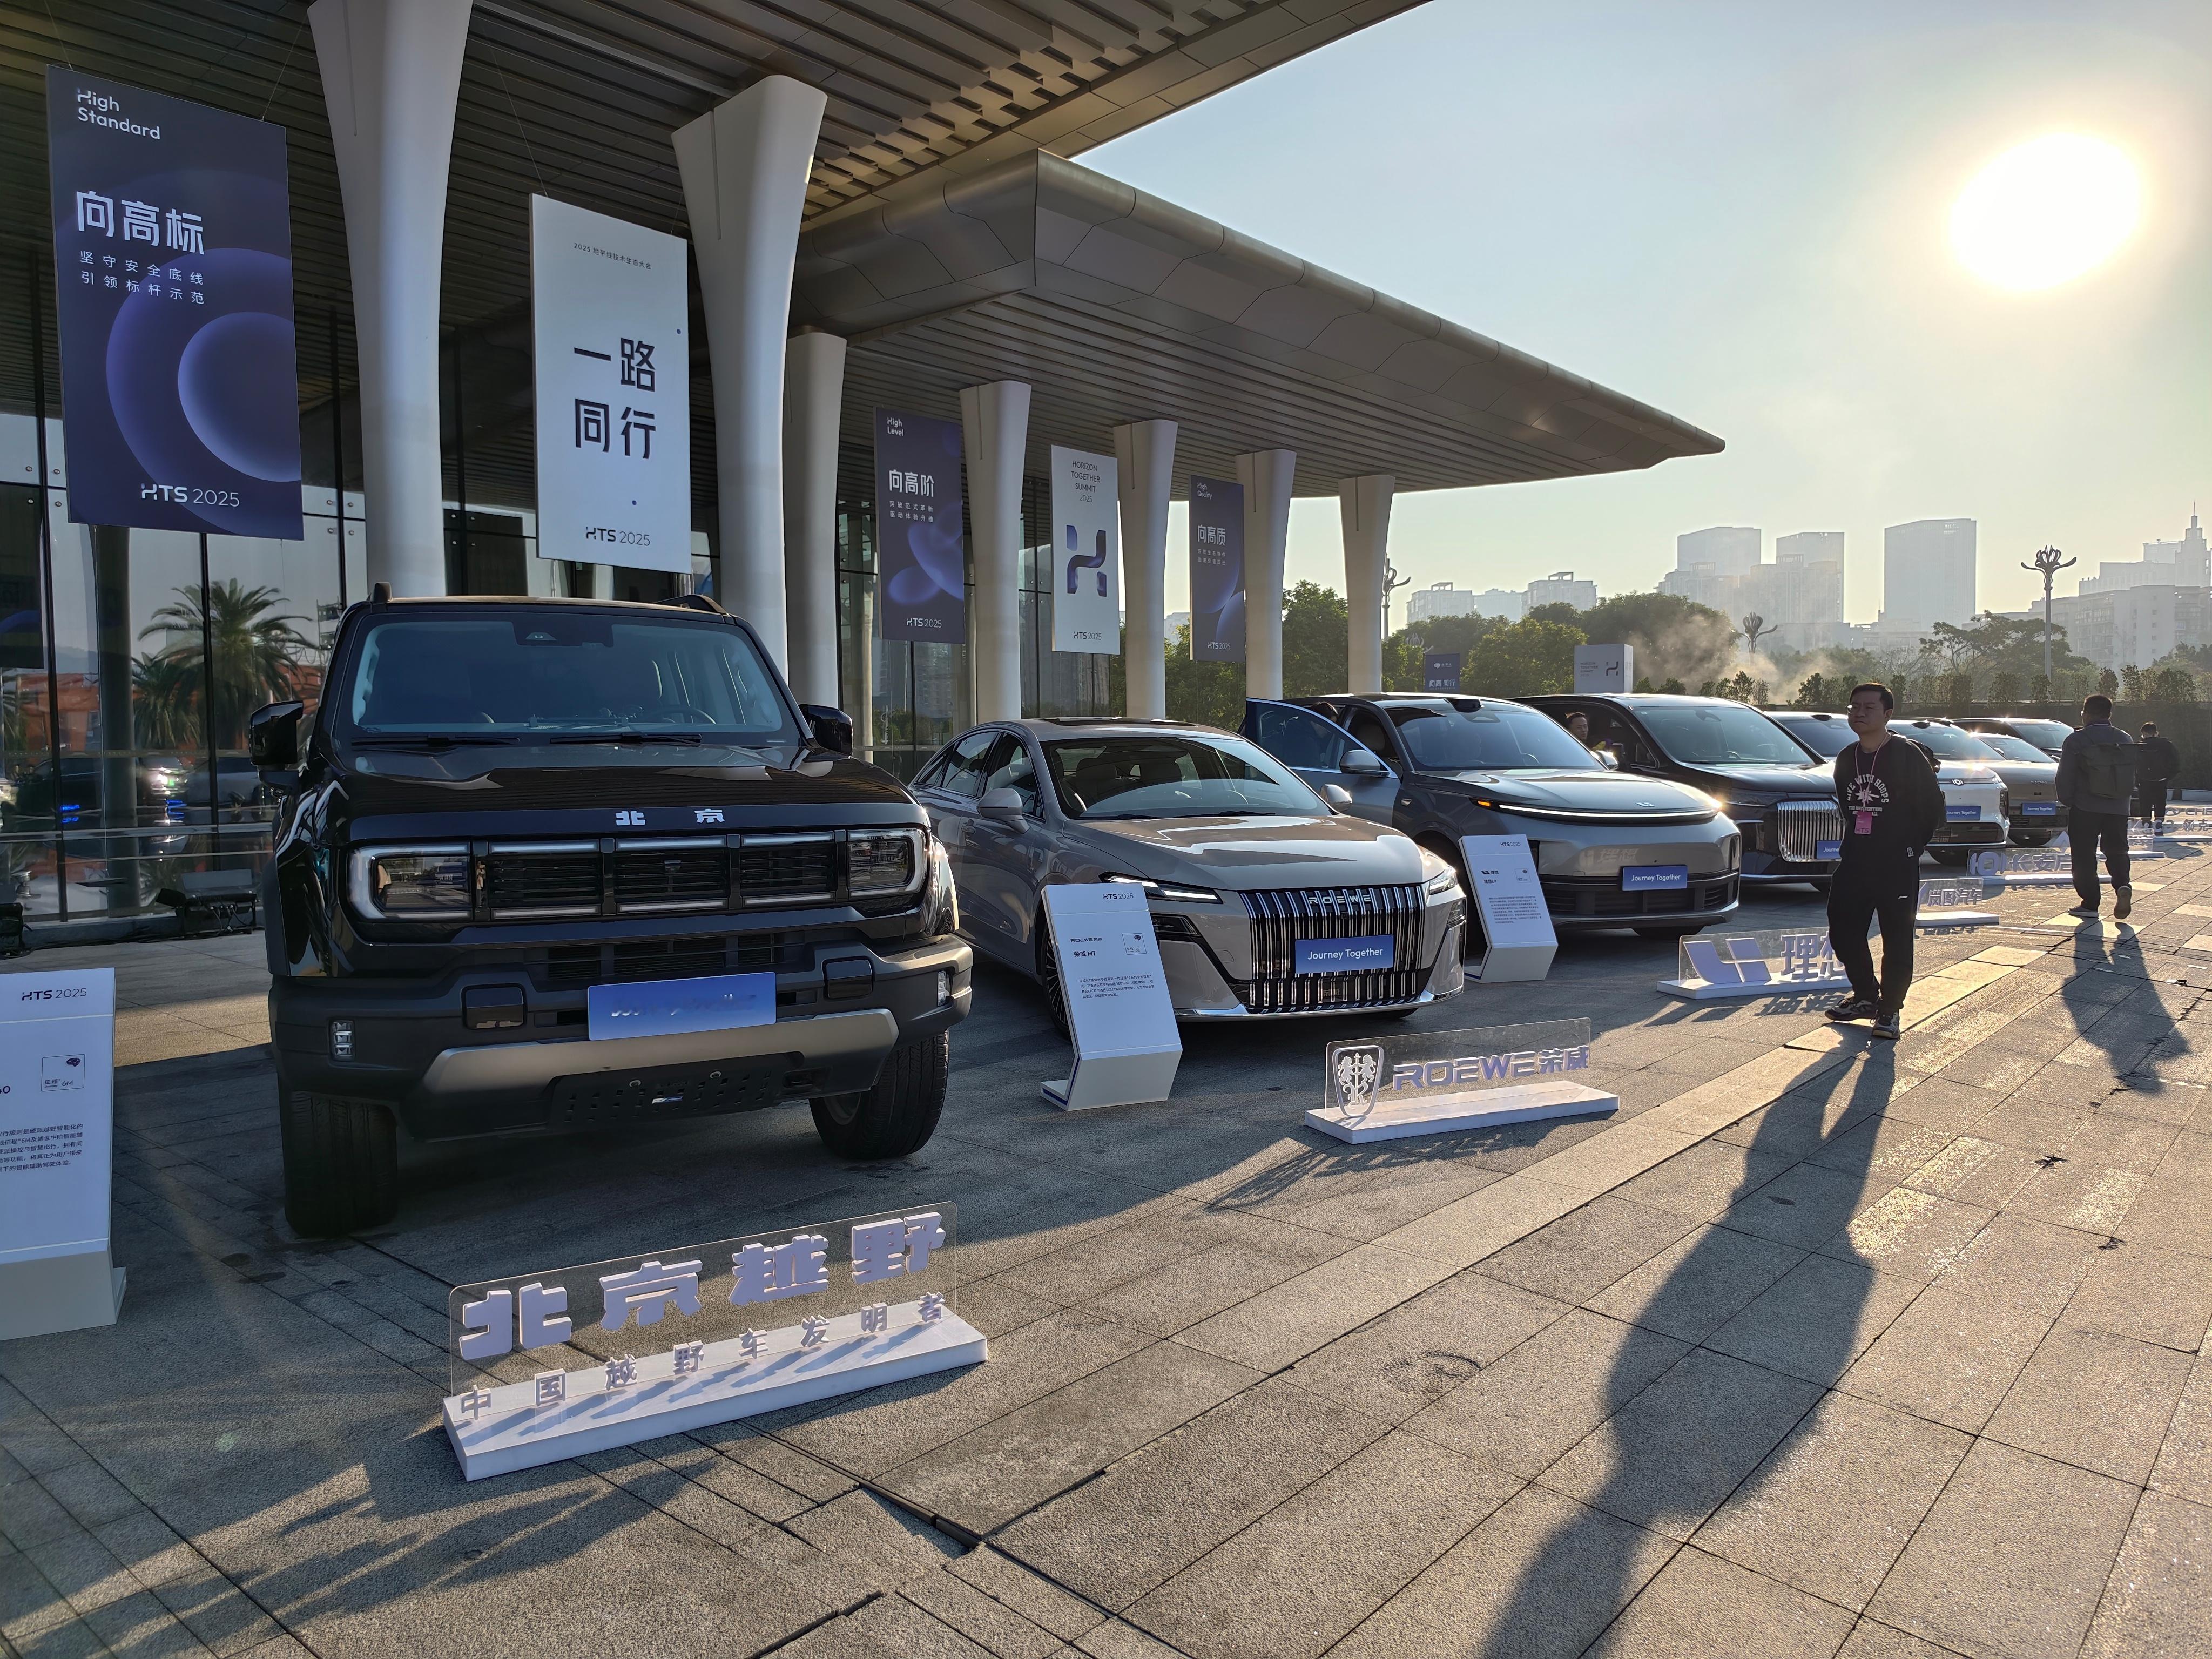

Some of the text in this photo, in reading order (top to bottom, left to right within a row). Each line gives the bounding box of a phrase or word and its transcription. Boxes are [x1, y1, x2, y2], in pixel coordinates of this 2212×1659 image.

[78, 88, 119, 112] High
[78, 108, 160, 139] Standard
[77, 191, 205, 254] 向高标
[574, 243, 590, 252] 2025
[80, 251, 203, 285] 坚守安全底线
[81, 271, 204, 305] 引领标杆示范
[574, 337, 656, 392] 一路
[575, 399, 656, 459] 同行
[887, 416, 902, 428] High
[887, 427, 904, 436] Level
[1072, 460, 1097, 471] HORIZON
[889, 469, 934, 497] 向高阶
[1071, 471, 1101, 483] TOGETHER
[141, 483, 240, 507] HTS 2025
[1075, 483, 1097, 493] SUMMIT
[1197, 490, 1212, 500] Quality
[1080, 494, 1092, 503] 2025
[586, 527, 650, 546] HTS 2025
[1197, 524, 1226, 546] 向高质
[906, 618, 942, 628] HTS 2025
[1074, 631, 1087, 639] HTS
[1443, 679, 1456, 687] 同行
[616, 808, 725, 825] 北京
[2183, 819, 2209, 832] 领克
[1308, 894, 1372, 905] ROEWE
[1307, 948, 1384, 960] Journey Together
[22, 988, 87, 1000] HTS 2025
[1393, 1044, 1589, 1090] ROEWE 荣威
[458, 1211, 946, 1361] 北京越野
[460, 1291, 945, 1420] 中国越野车发明者
